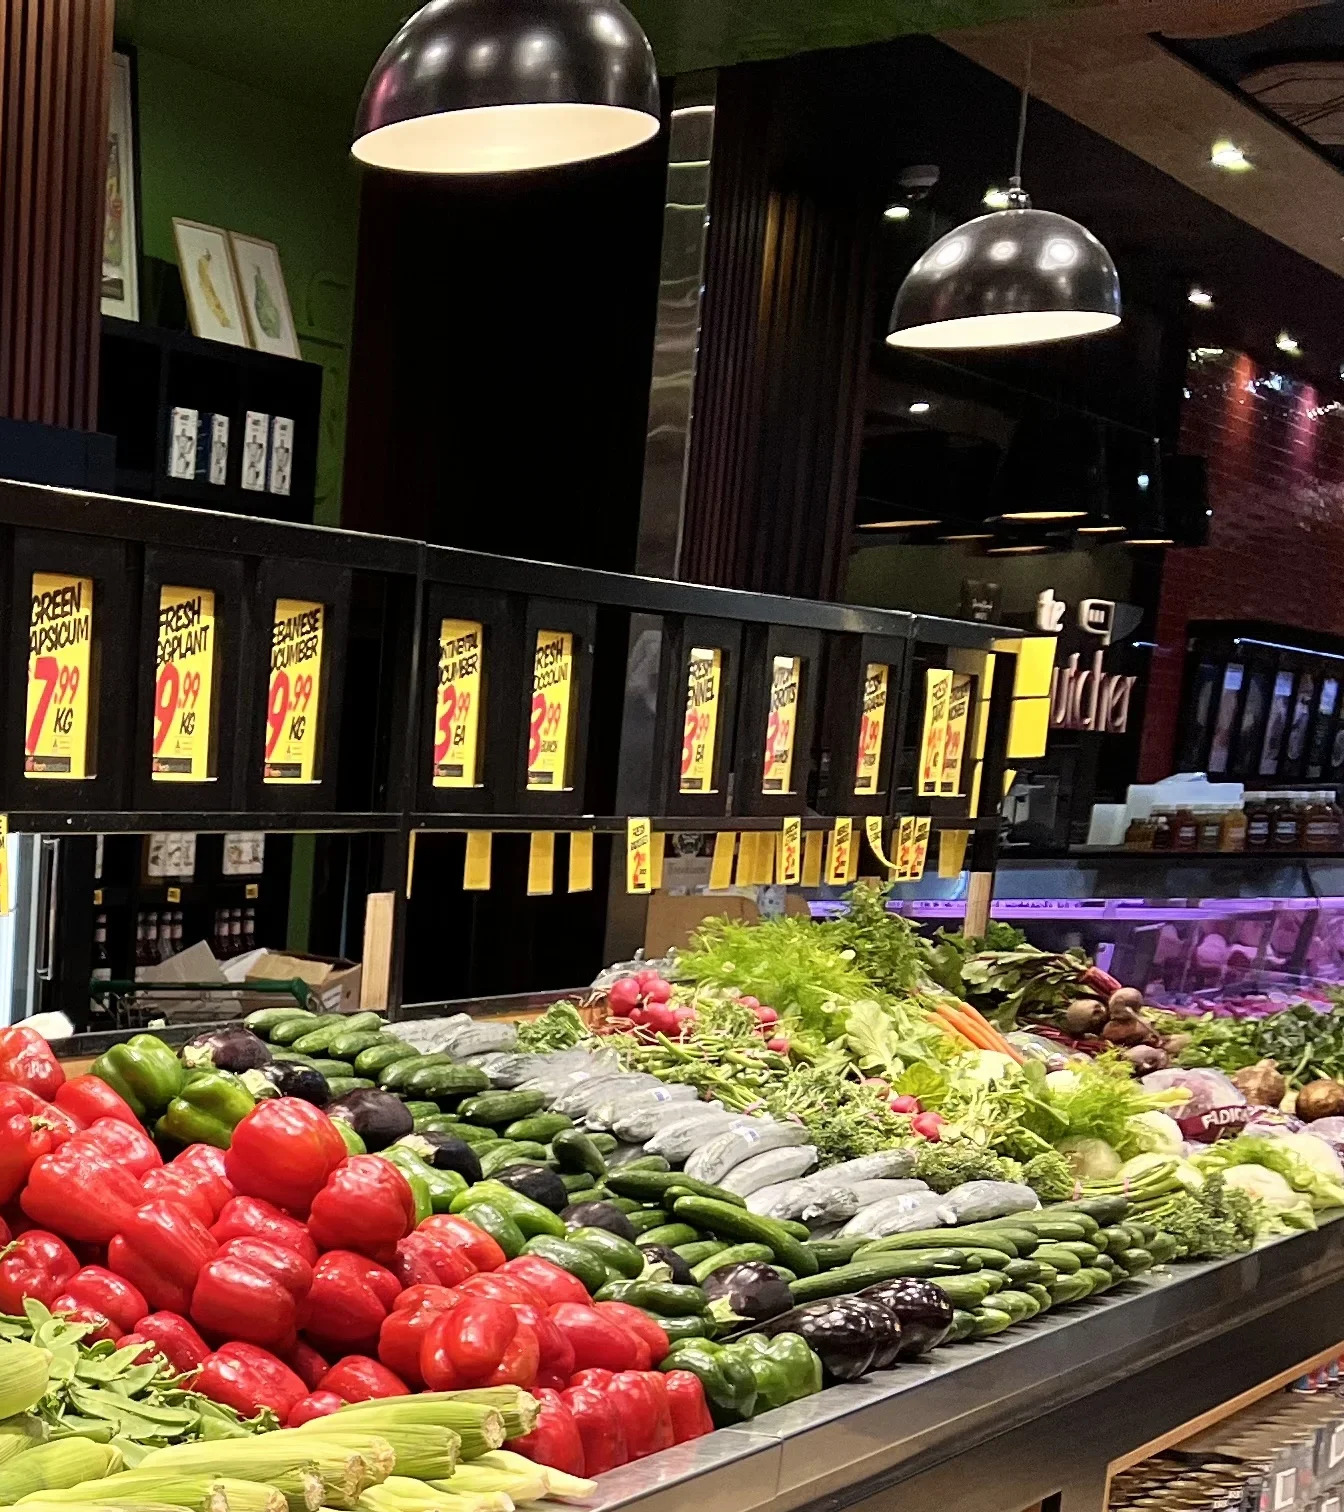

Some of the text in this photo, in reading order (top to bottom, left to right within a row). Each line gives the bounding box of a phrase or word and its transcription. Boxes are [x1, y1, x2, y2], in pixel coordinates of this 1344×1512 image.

[31, 582, 82, 626] GREEN
[160, 596, 201, 635] FRESH
[30, 615, 89, 656] APSICUM
[54, 708, 73, 734] KG
[180, 712, 195, 735] KG
[289, 716, 305, 740] KG
